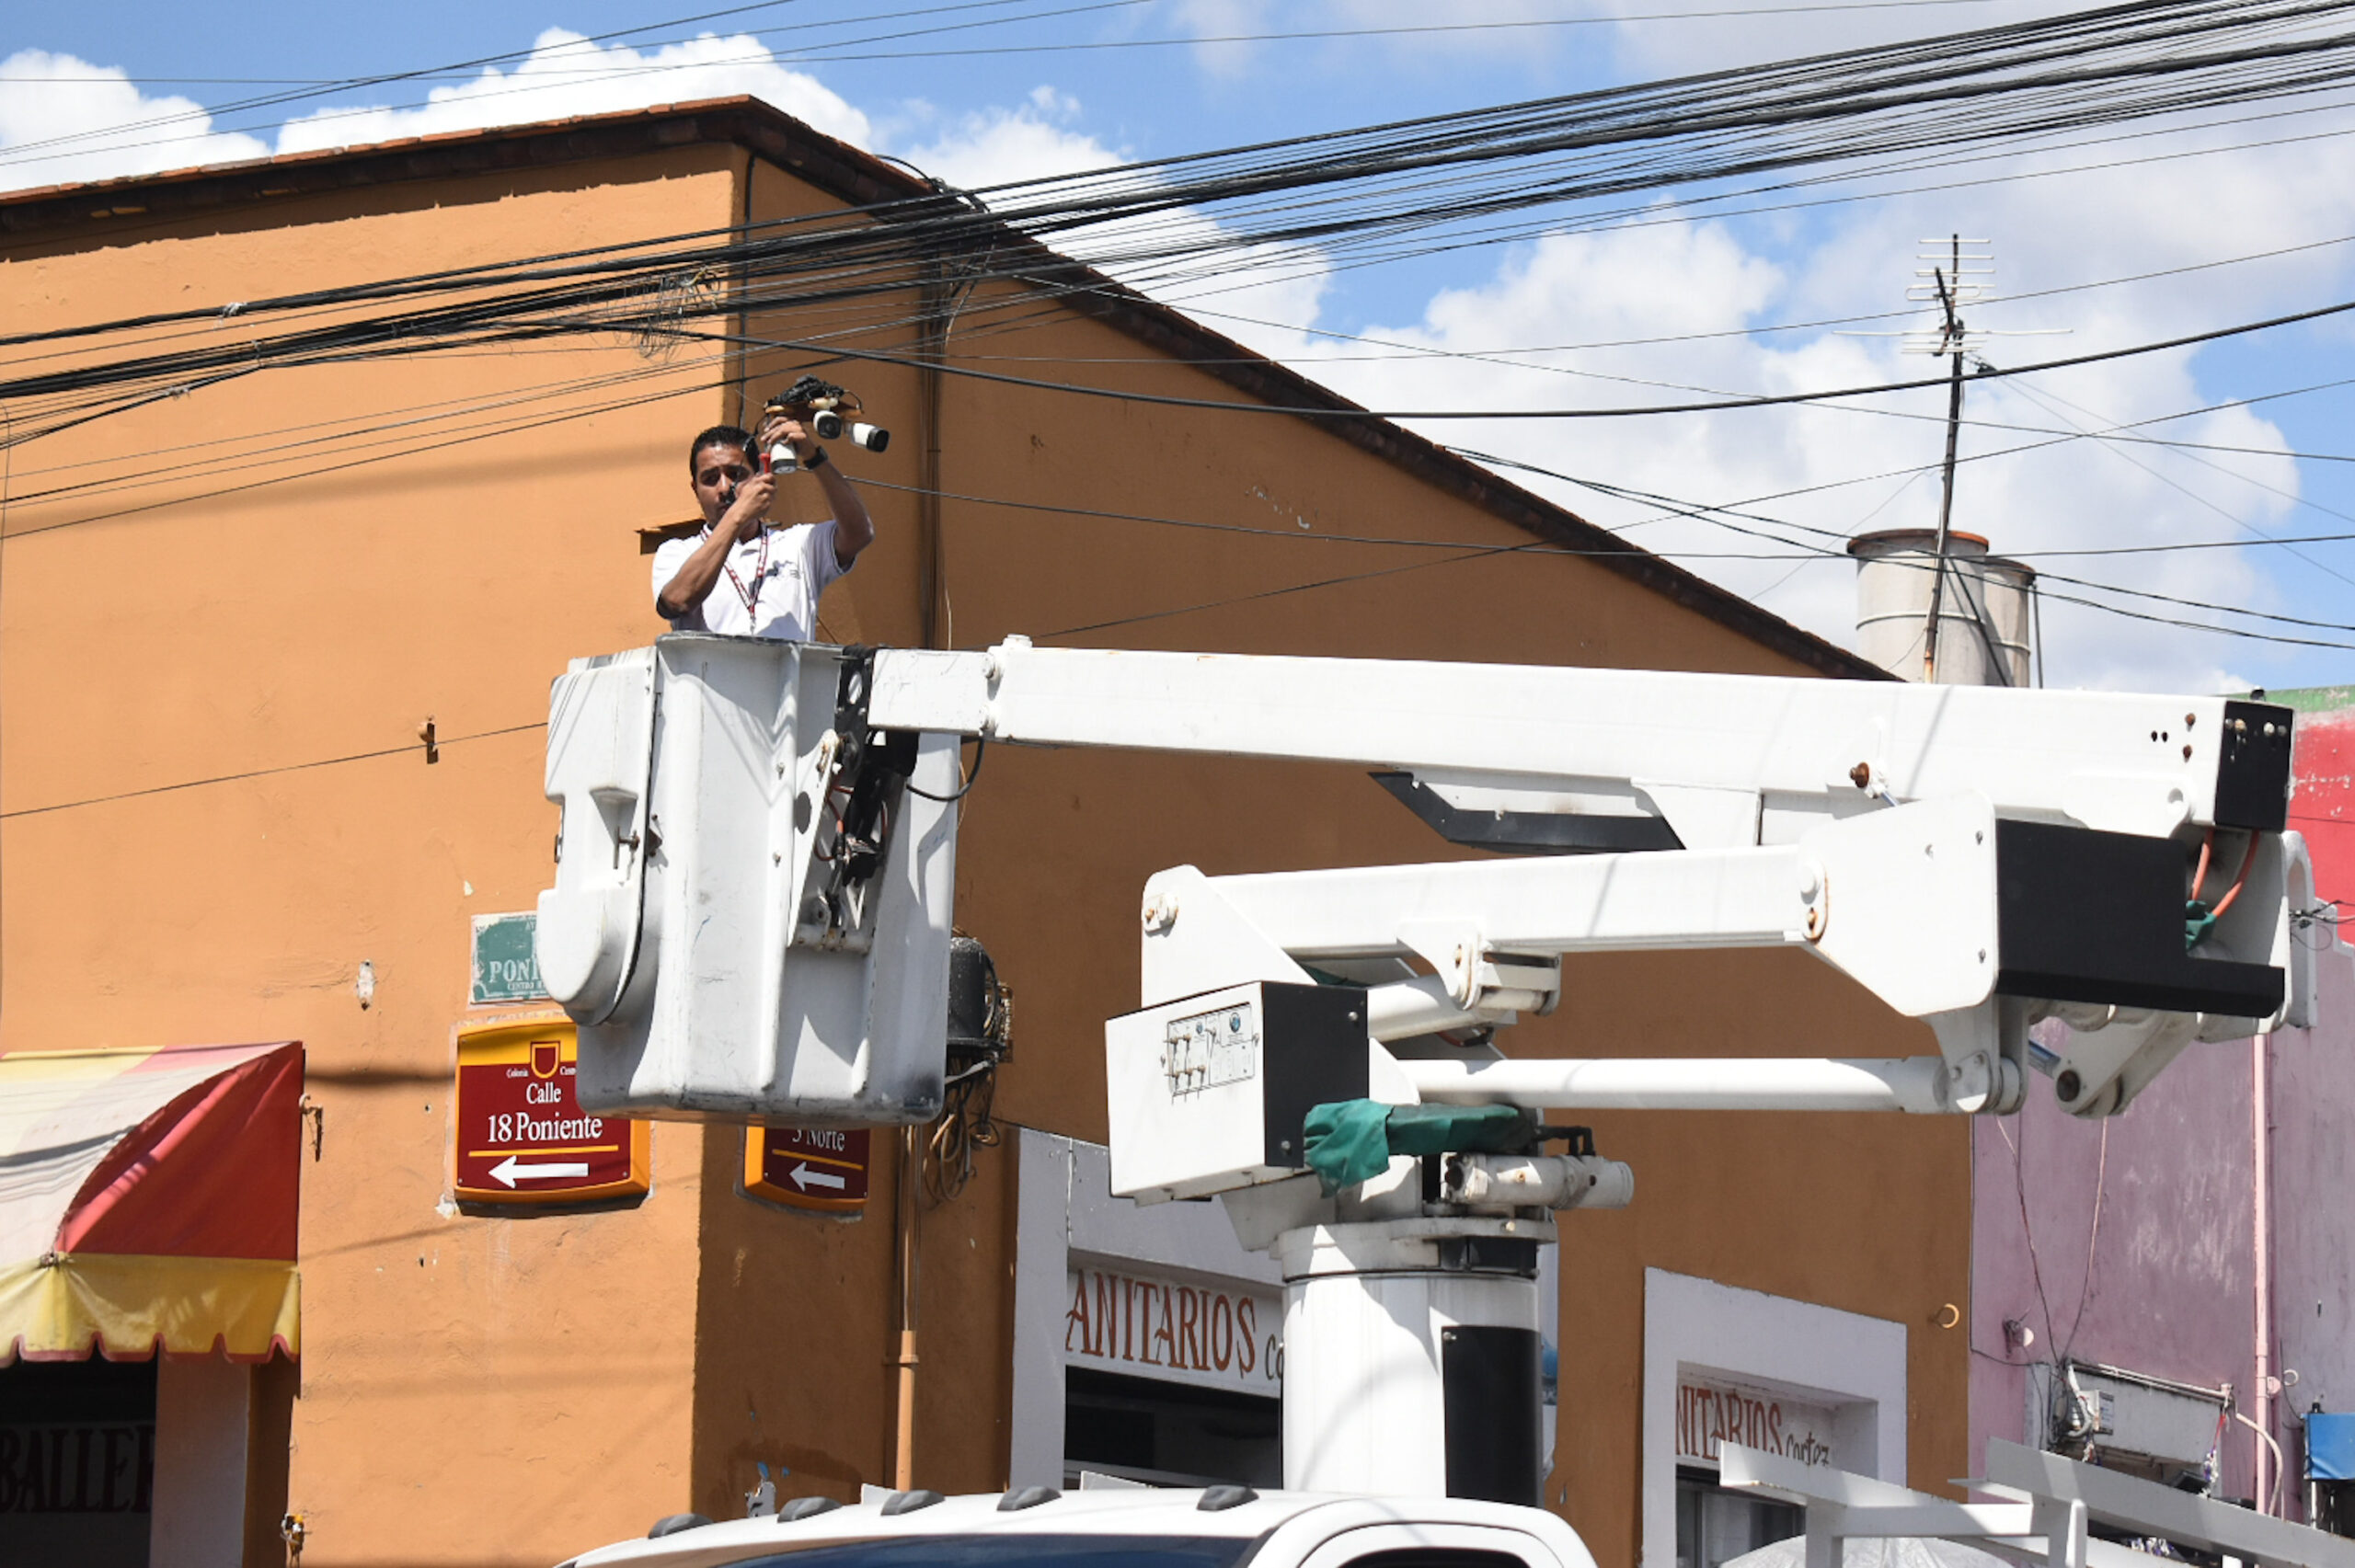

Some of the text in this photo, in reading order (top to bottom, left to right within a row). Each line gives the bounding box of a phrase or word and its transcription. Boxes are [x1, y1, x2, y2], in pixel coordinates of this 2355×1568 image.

[526, 1082, 562, 1104] Calle
[488, 1111, 603, 1143] 18 Poniente
[807, 1129, 845, 1151] Norte
